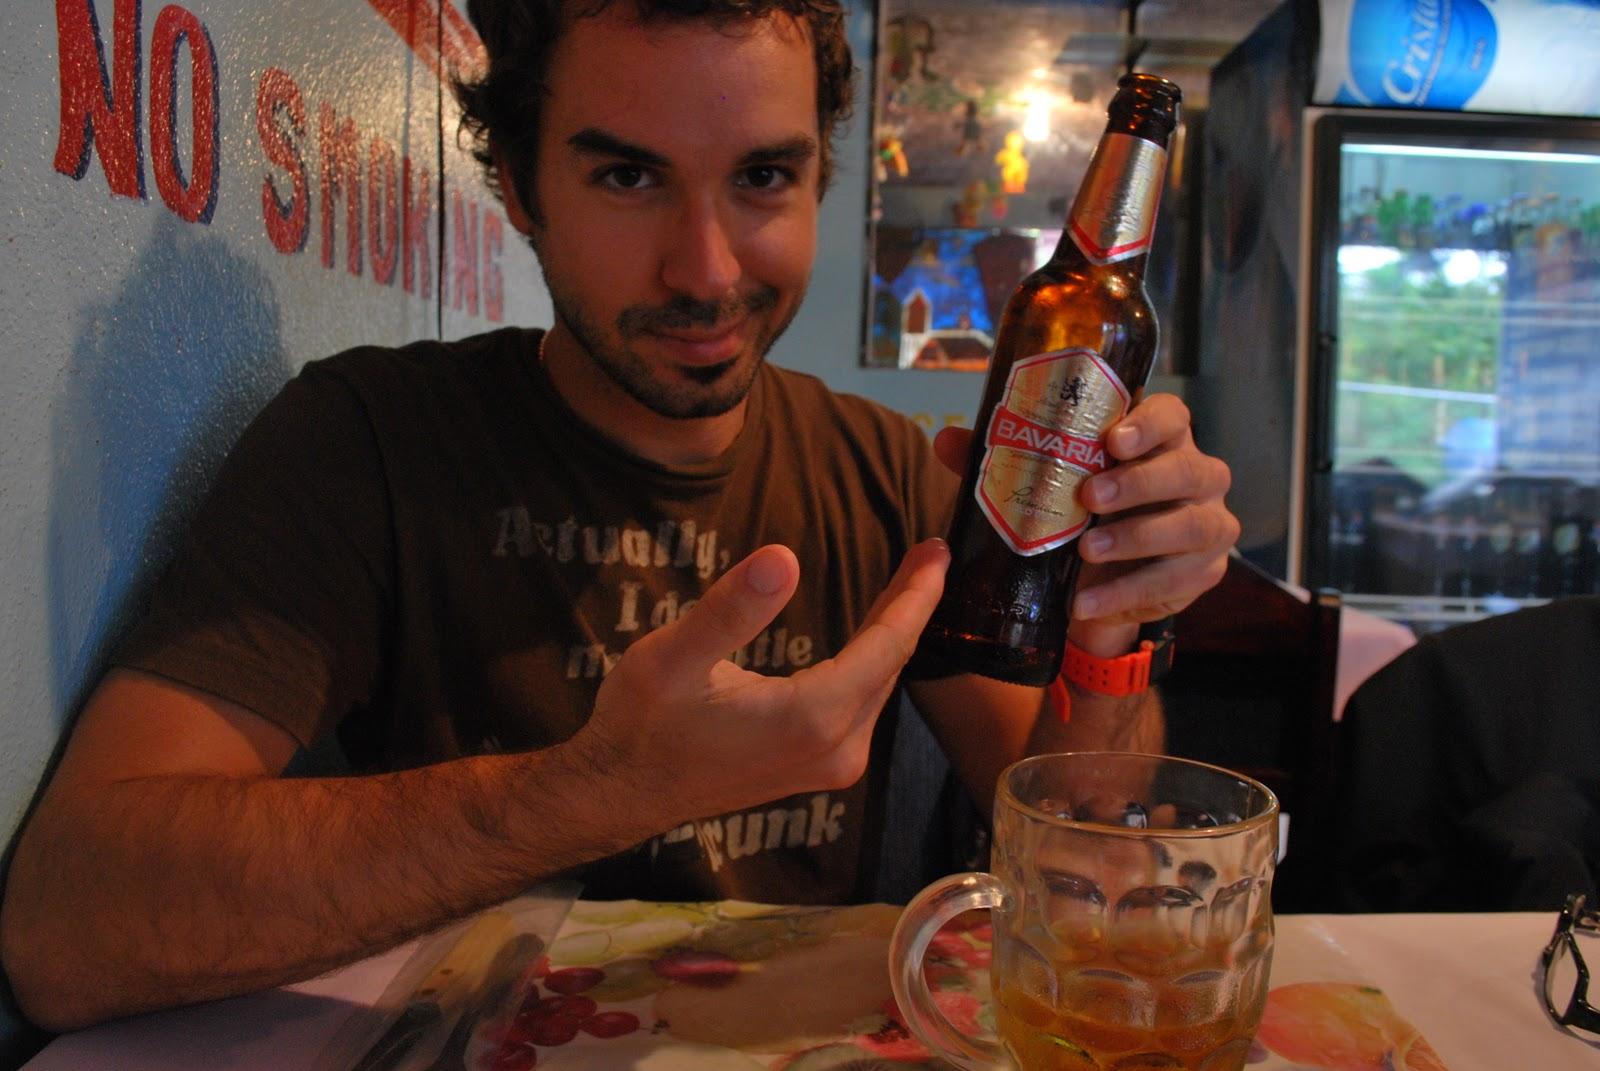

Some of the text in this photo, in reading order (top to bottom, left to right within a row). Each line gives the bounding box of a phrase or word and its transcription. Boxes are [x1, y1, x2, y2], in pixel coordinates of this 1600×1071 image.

[53, 0, 220, 225] NO
[996, 419, 1106, 468] BAVARIA
[493, 504, 732, 580] Actually,
[614, 580, 643, 632] I
[662, 793, 847, 873] runk
